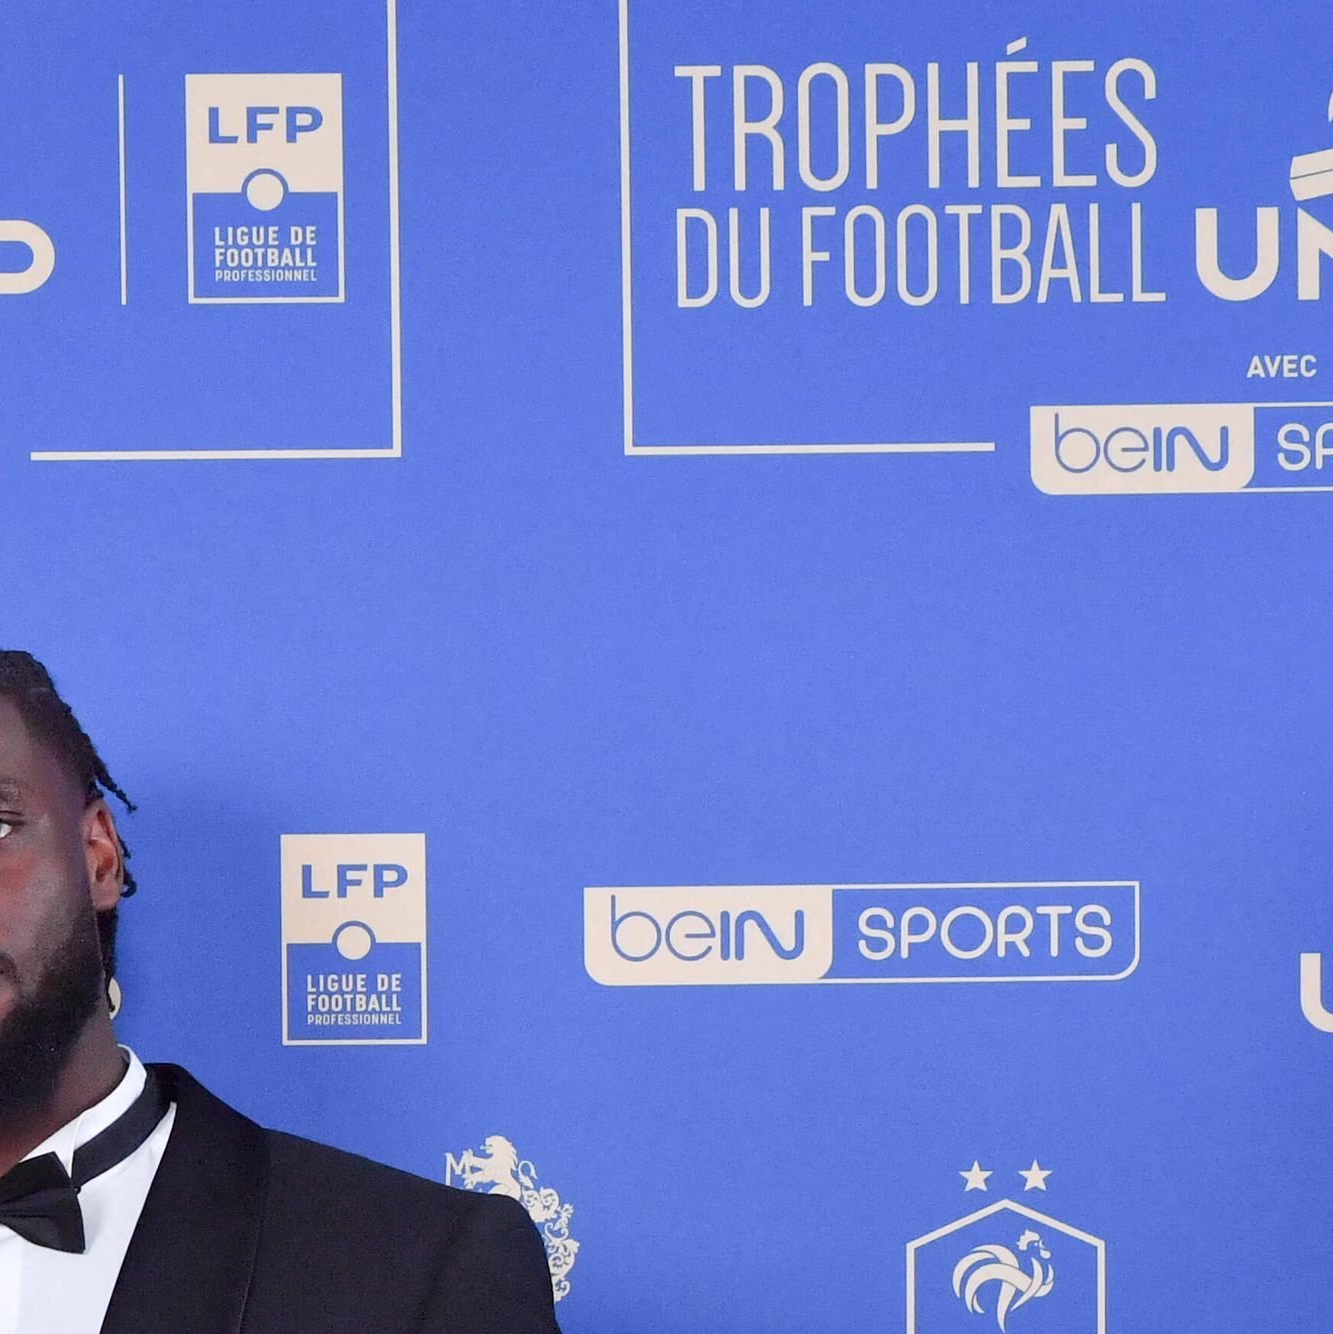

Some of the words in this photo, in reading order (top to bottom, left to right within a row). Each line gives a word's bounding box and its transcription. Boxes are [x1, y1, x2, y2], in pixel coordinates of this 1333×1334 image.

[209, 107, 323, 143] LFP
[675, 37, 1156, 191] TROPHÉES
[215, 227, 278, 245] LIGUE
[291, 226, 316, 245] DE
[215, 248, 316, 267] FOOTBALL
[677, 208, 770, 308] DU
[802, 203, 1165, 306] FOOTBALL
[216, 270, 316, 281] PROFESSIONNEL
[1247, 355, 1316, 377] AVEC
[1055, 413, 1229, 473] beIN
[302, 864, 407, 898] LFP
[611, 895, 804, 961] beIN
[859, 905, 1112, 960] SPORTS
[308, 974, 366, 992] LIGUE
[378, 974, 401, 991] DE
[308, 994, 401, 1011] FOOTBALL
[308, 1014, 401, 1025] PROFESSIONNEL
